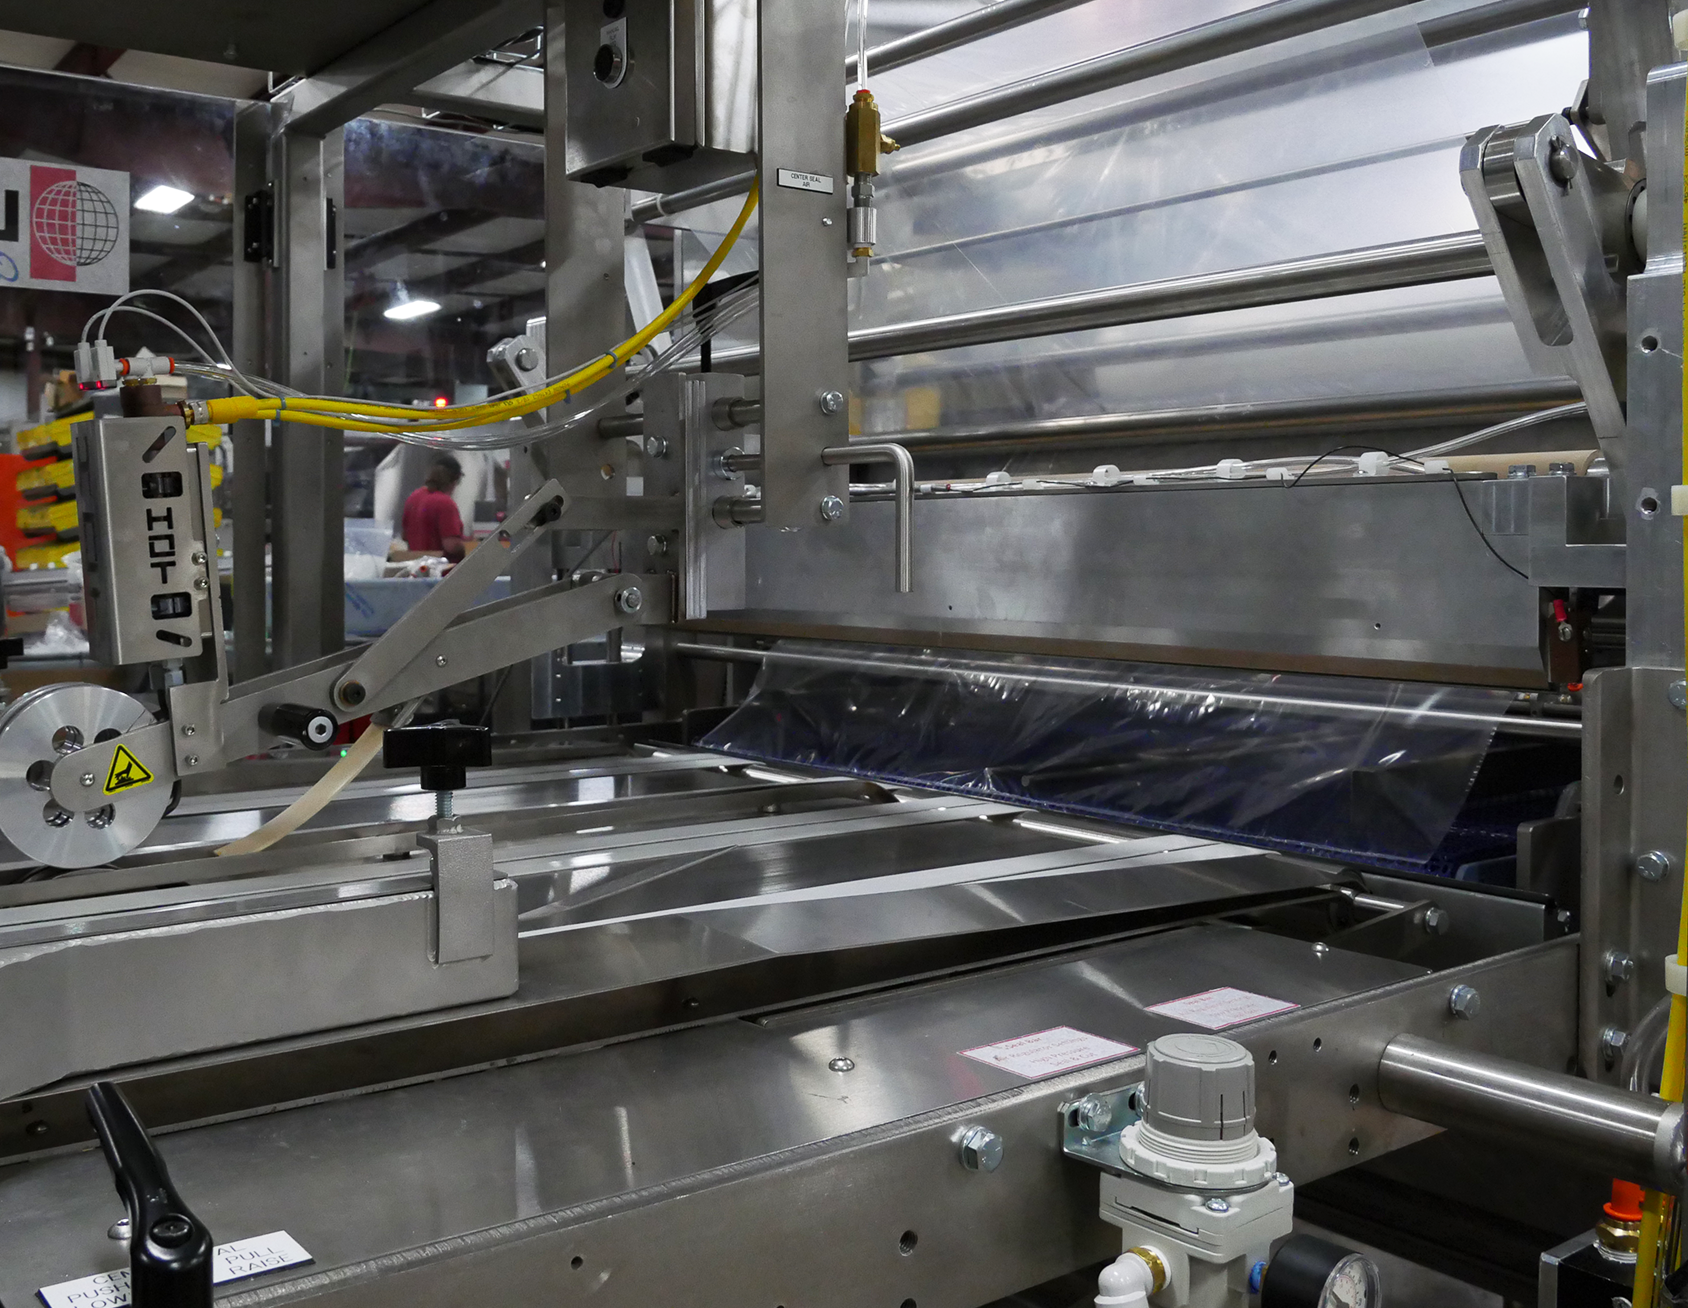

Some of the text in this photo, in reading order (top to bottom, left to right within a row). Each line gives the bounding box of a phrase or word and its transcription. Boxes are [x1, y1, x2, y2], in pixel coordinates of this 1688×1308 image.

[790, 172, 822, 183] CENTER SEAL
[145, 506, 177, 585] HOT
[66, 1246, 285, 1304] PUSH PULL
[92, 1244, 247, 1285] CEN AL
[228, 1252, 294, 1275] RAISE
